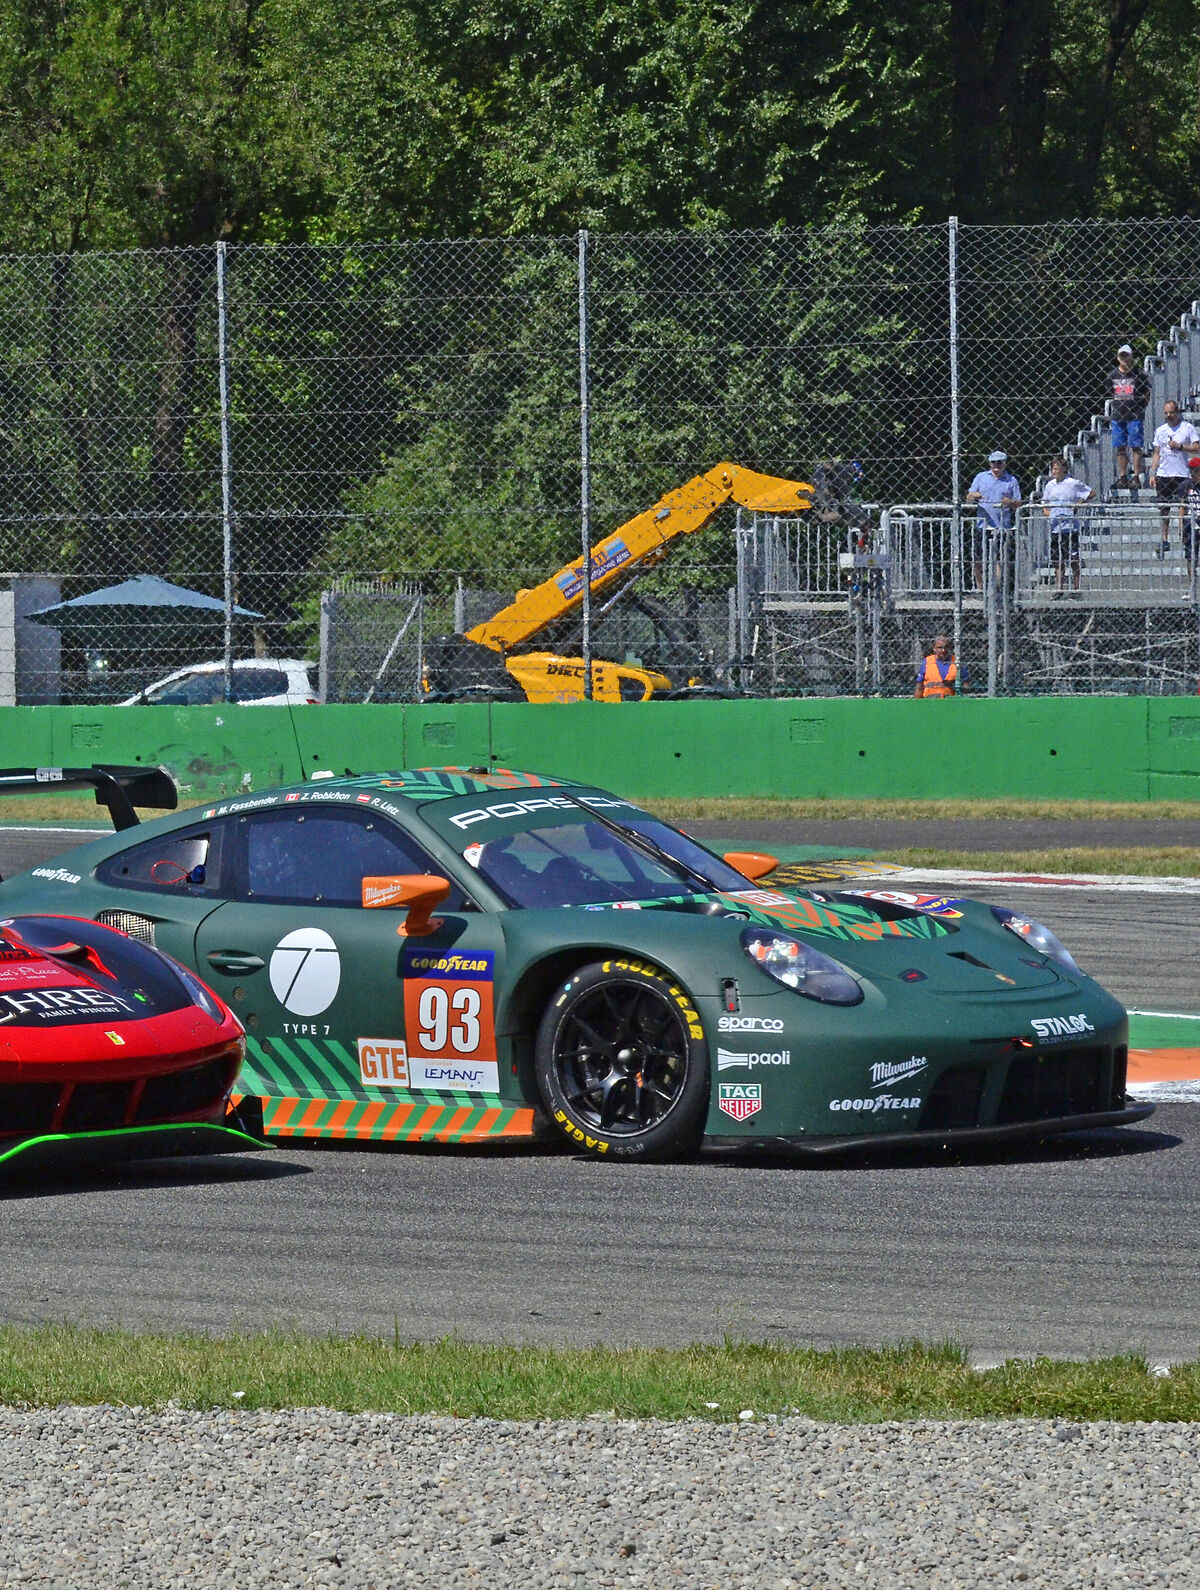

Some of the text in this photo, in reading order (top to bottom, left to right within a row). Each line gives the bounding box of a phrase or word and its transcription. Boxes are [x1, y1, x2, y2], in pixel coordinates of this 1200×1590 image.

[547, 664, 586, 679] DIEC
[448, 796, 645, 830] PORSCH
[410, 955, 488, 973] GOODYEAR
[283, 1023, 331, 1035] TYPE 7
[418, 986, 481, 1054] 93
[717, 1015, 784, 1033] sparco
[361, 1045, 407, 1080] GTE
[748, 1050, 791, 1070] paoli
[868, 1055, 930, 1083] Milwaukee
[721, 1085, 759, 1098] TAG
[720, 1099, 761, 1119] HEUER
[829, 1093, 922, 1114] GOODYEAR
[553, 1109, 609, 1155] EAGLE
